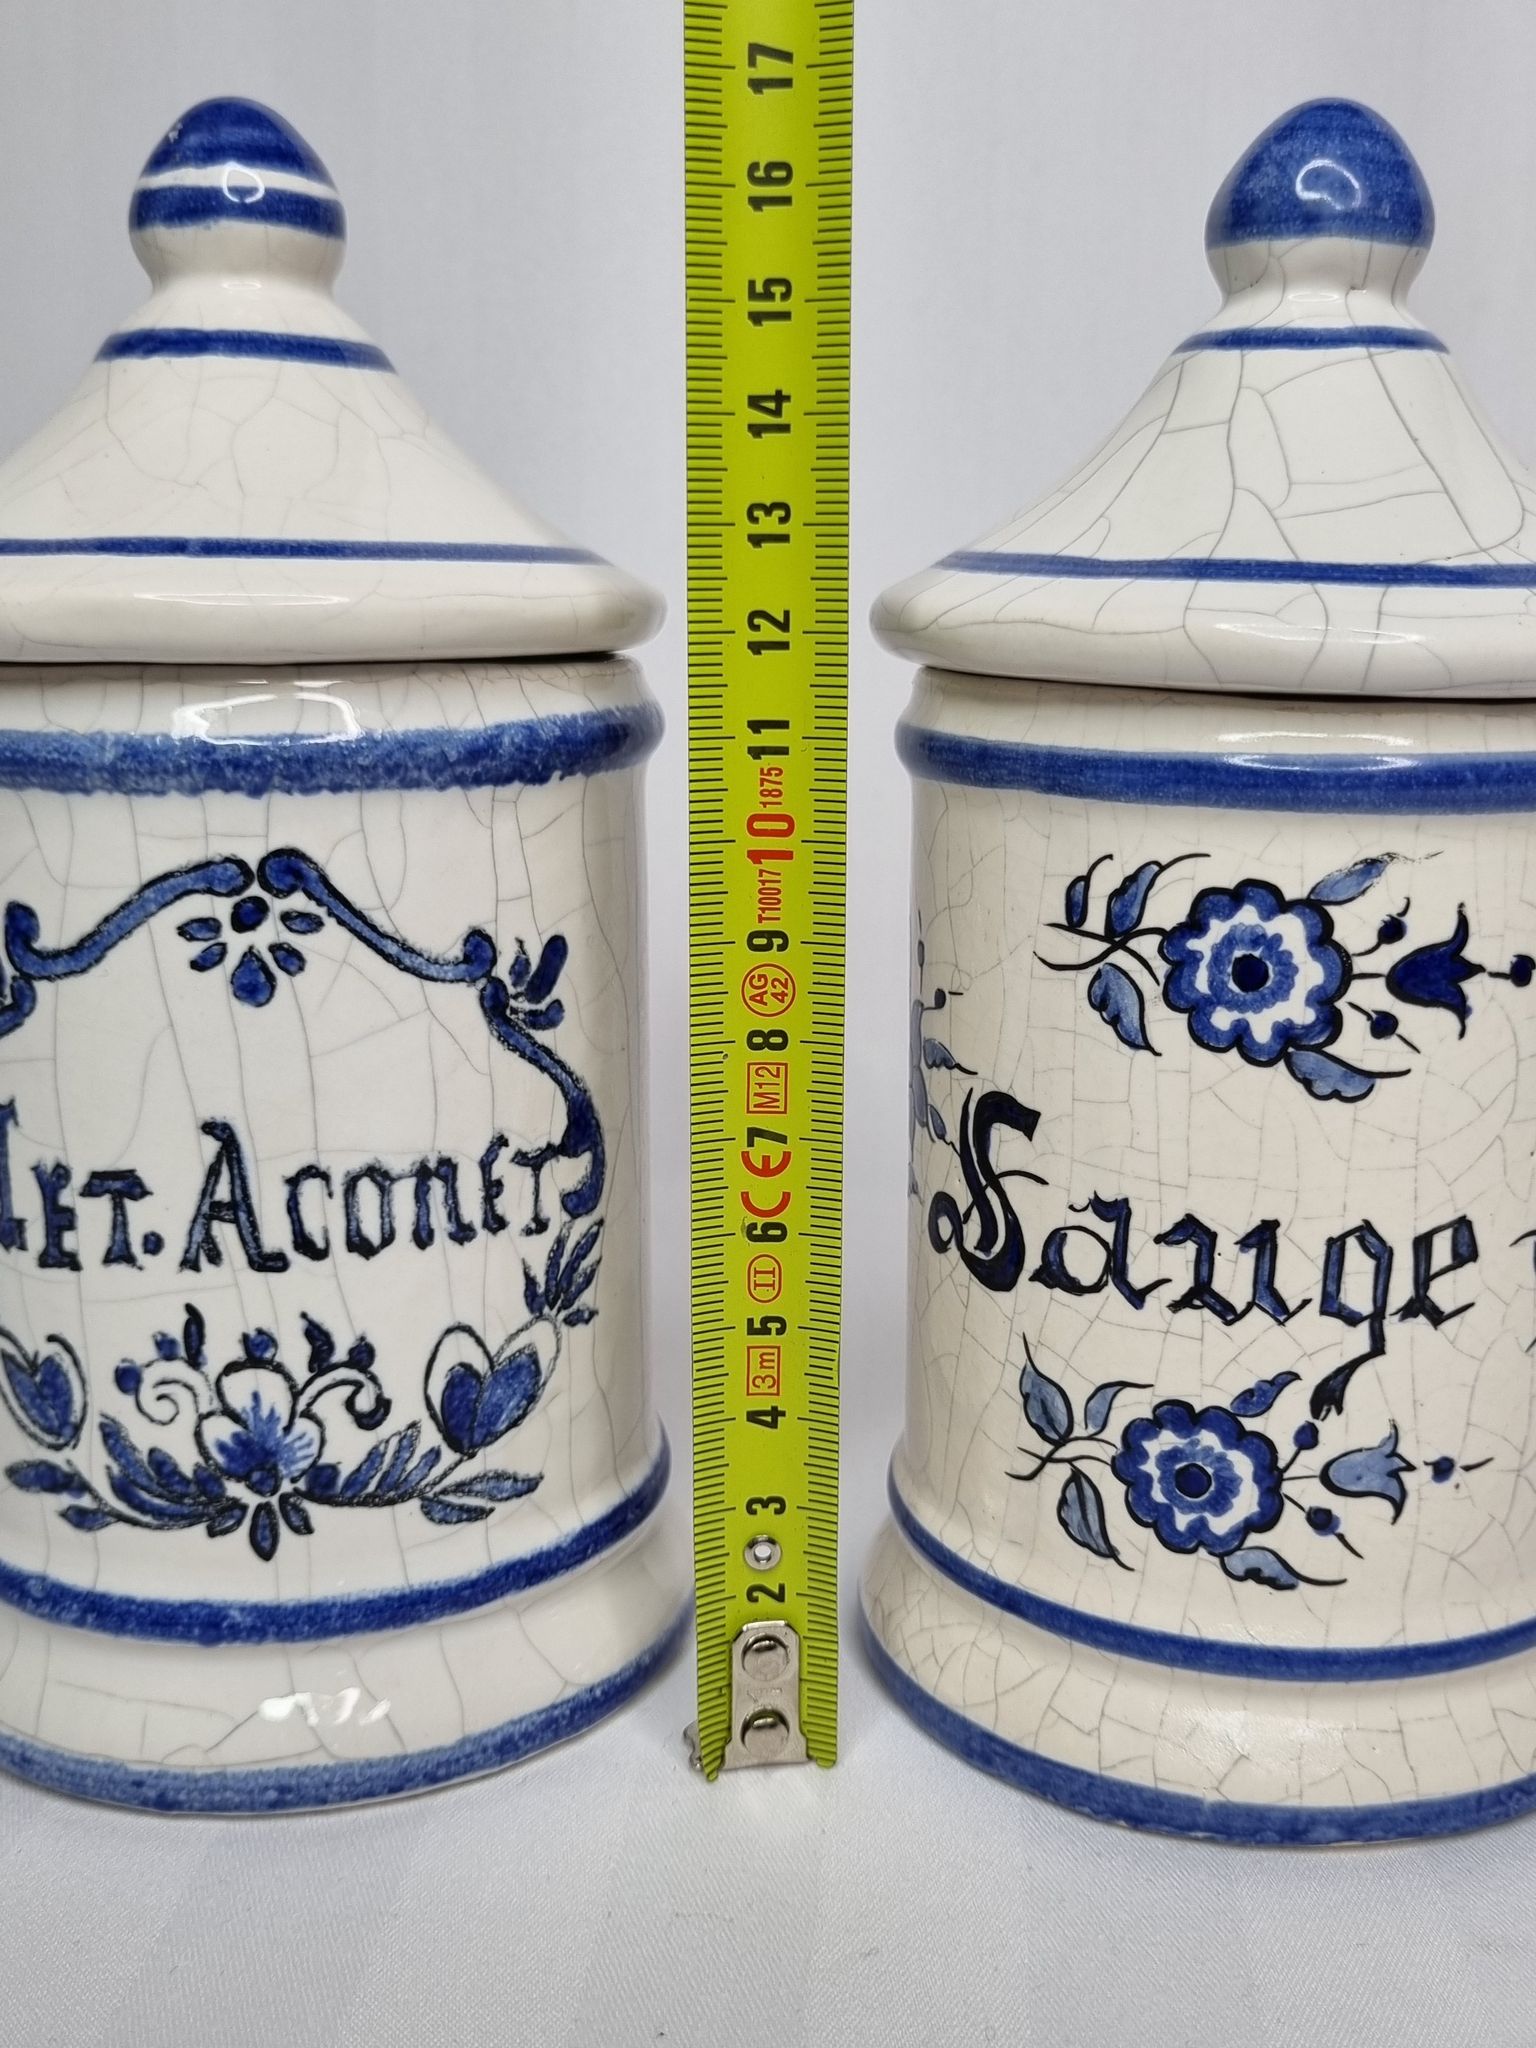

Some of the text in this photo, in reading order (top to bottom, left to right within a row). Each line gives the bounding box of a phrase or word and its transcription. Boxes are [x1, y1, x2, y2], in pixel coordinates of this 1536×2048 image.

[748, 43, 793, 95] 17
[747, 161, 793, 212] 16
[748, 278, 792, 327] 15
[747, 389, 791, 439] 14
[747, 502, 791, 549] 13
[747, 610, 790, 655] 12
[747, 720, 790, 760] 11
[760, 767, 783, 808] 1875
[747, 813, 795, 865] 10
[758, 869, 782, 923] T10017
[747, 930, 789, 952] 9
[749, 974, 768, 1006] AG
[771, 977, 788, 1004] 42
[747, 1029, 788, 1051] 8
[753, 1066, 780, 1108] M12
[747, 1127, 787, 1147] 7
[746, 1222, 787, 1242] 6
[747, 1316, 786, 1336] 5
[746, 1406, 786, 1429] 4
[746, 1496, 786, 1515] 3
[746, 1583, 785, 1603] 2
